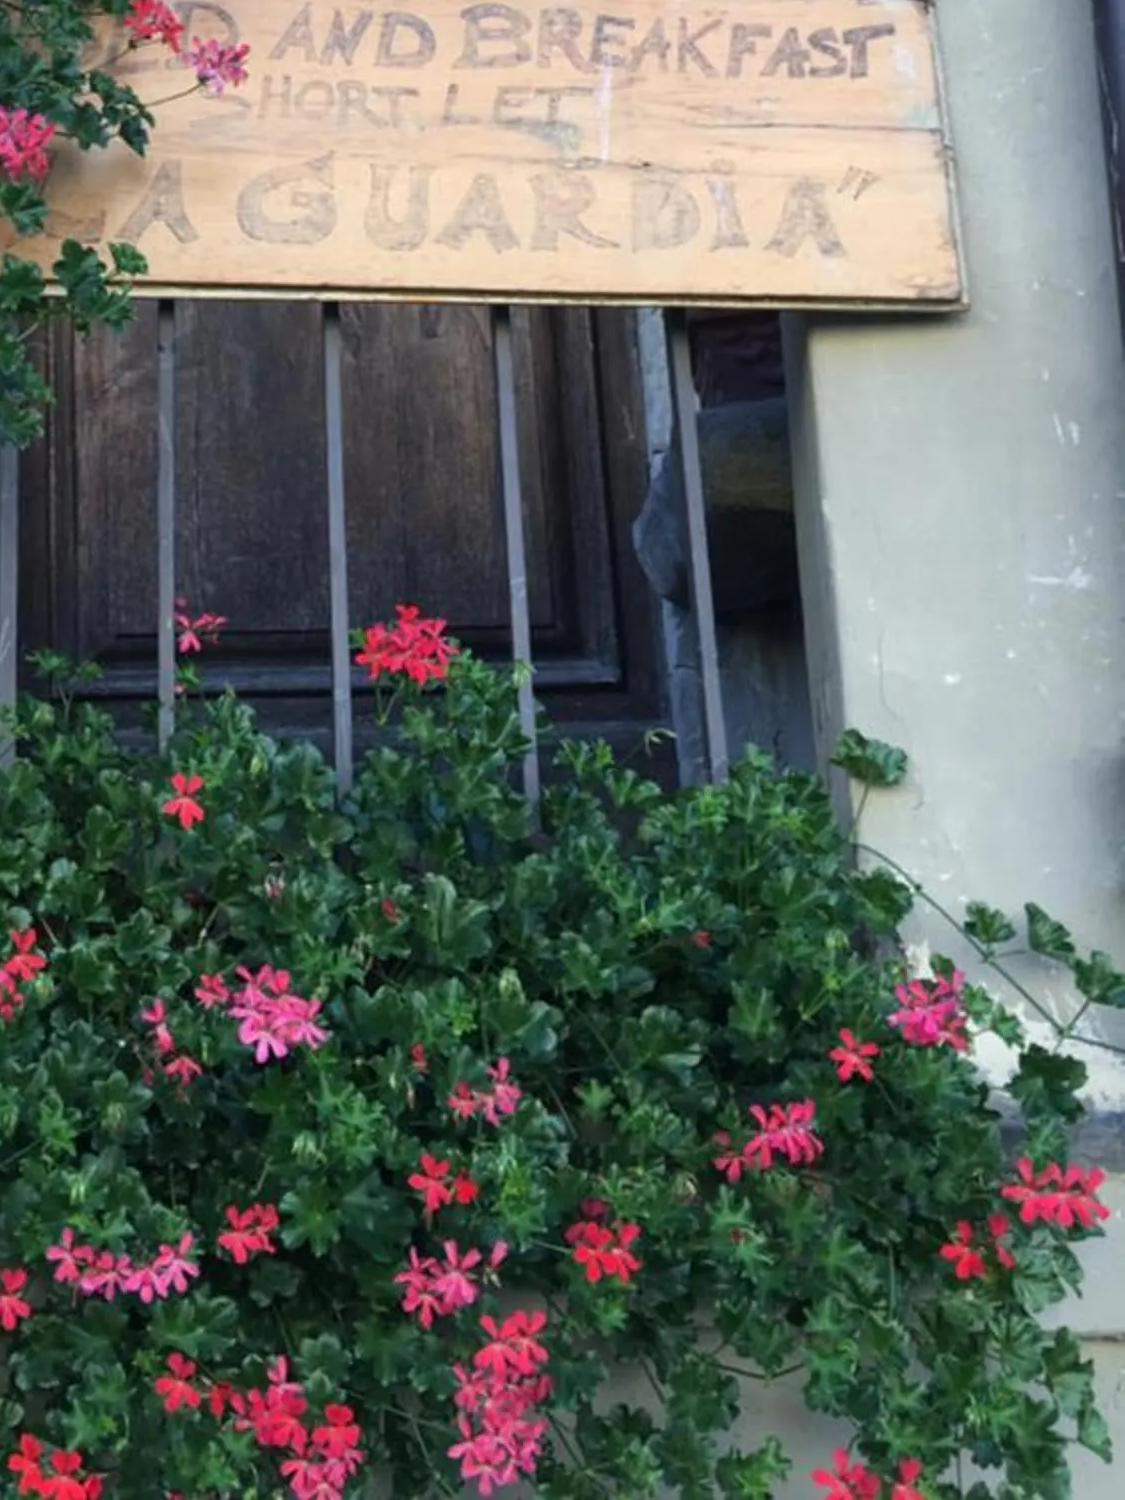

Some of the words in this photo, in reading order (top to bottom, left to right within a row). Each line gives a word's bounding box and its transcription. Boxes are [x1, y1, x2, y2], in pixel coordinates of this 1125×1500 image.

[269, 1, 437, 68] AND
[454, 3, 896, 80] BREAKFAST
[442, 83, 595, 129] LET
